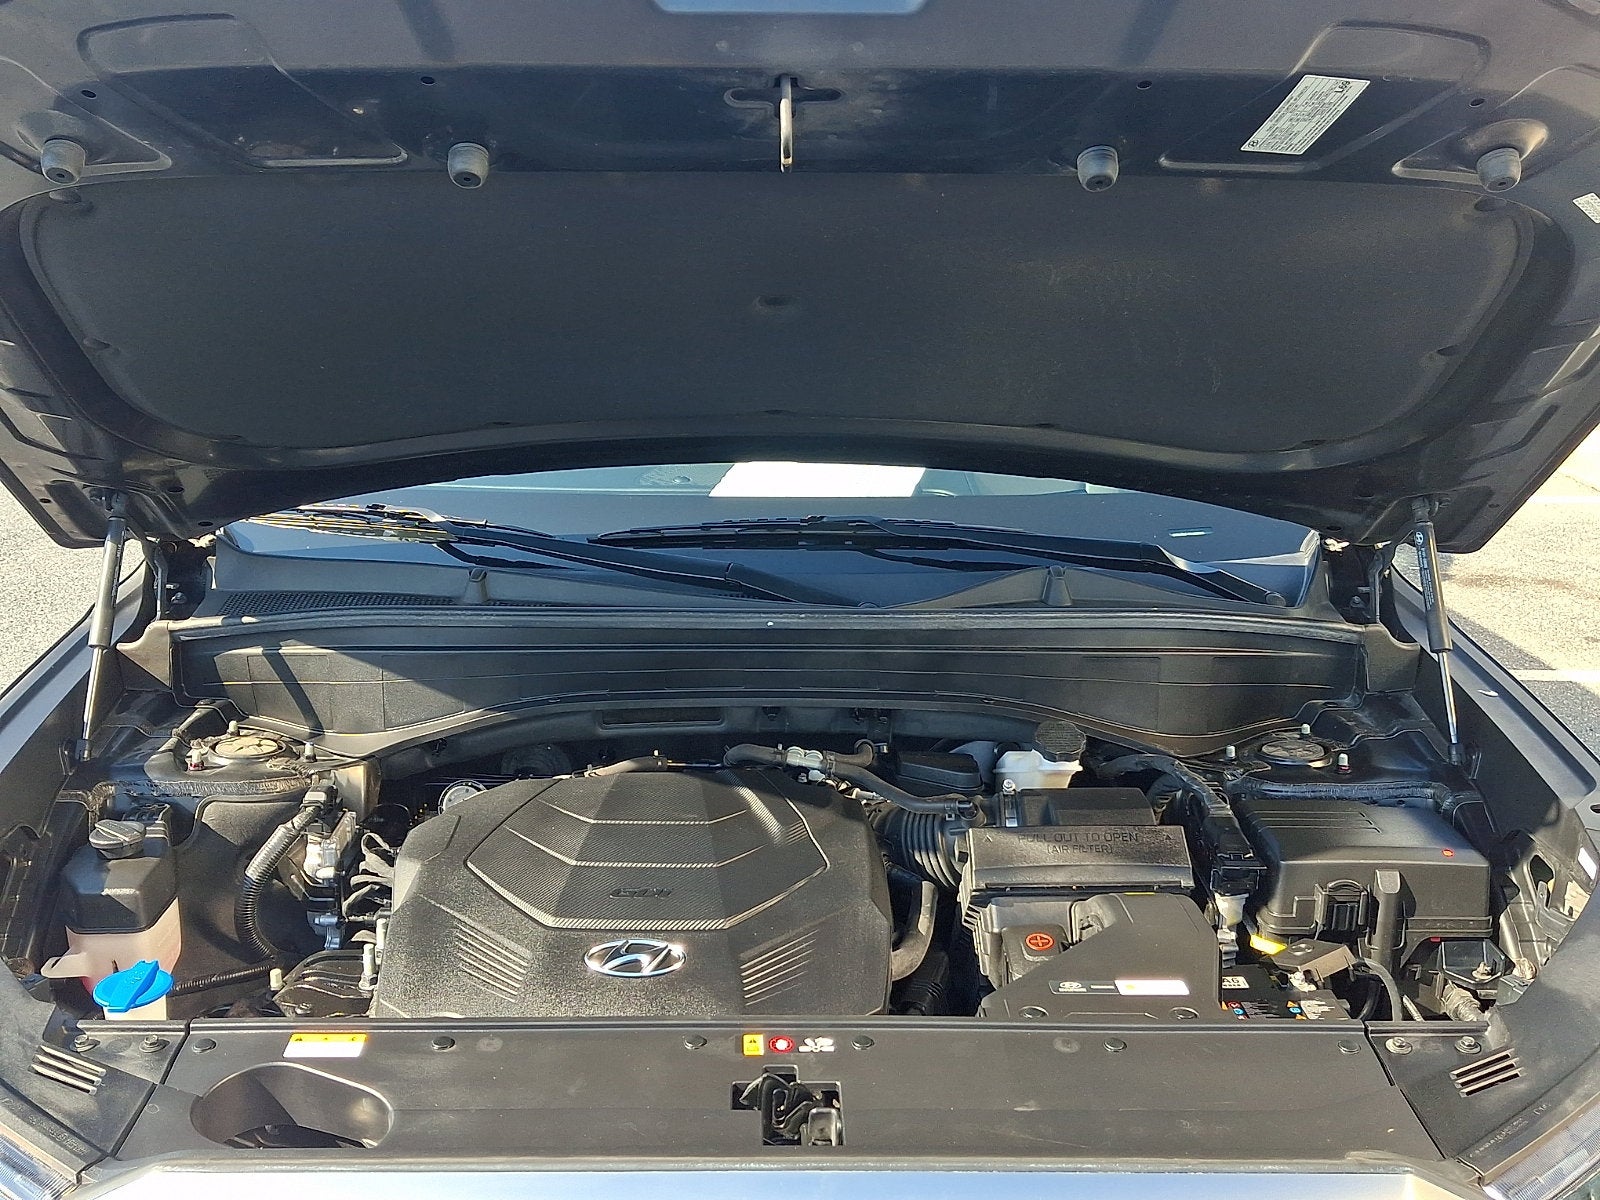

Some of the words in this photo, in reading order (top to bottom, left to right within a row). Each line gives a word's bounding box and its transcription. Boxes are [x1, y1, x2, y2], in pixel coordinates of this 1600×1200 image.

[1017, 832, 1050, 843] PULL
[1054, 832, 1079, 843] OUT
[1082, 832, 1101, 843] TO
[1103, 832, 1139, 843] OPEN
[1046, 844, 1070, 854] (AIR
[1072, 844, 1114, 854] FILTER)
